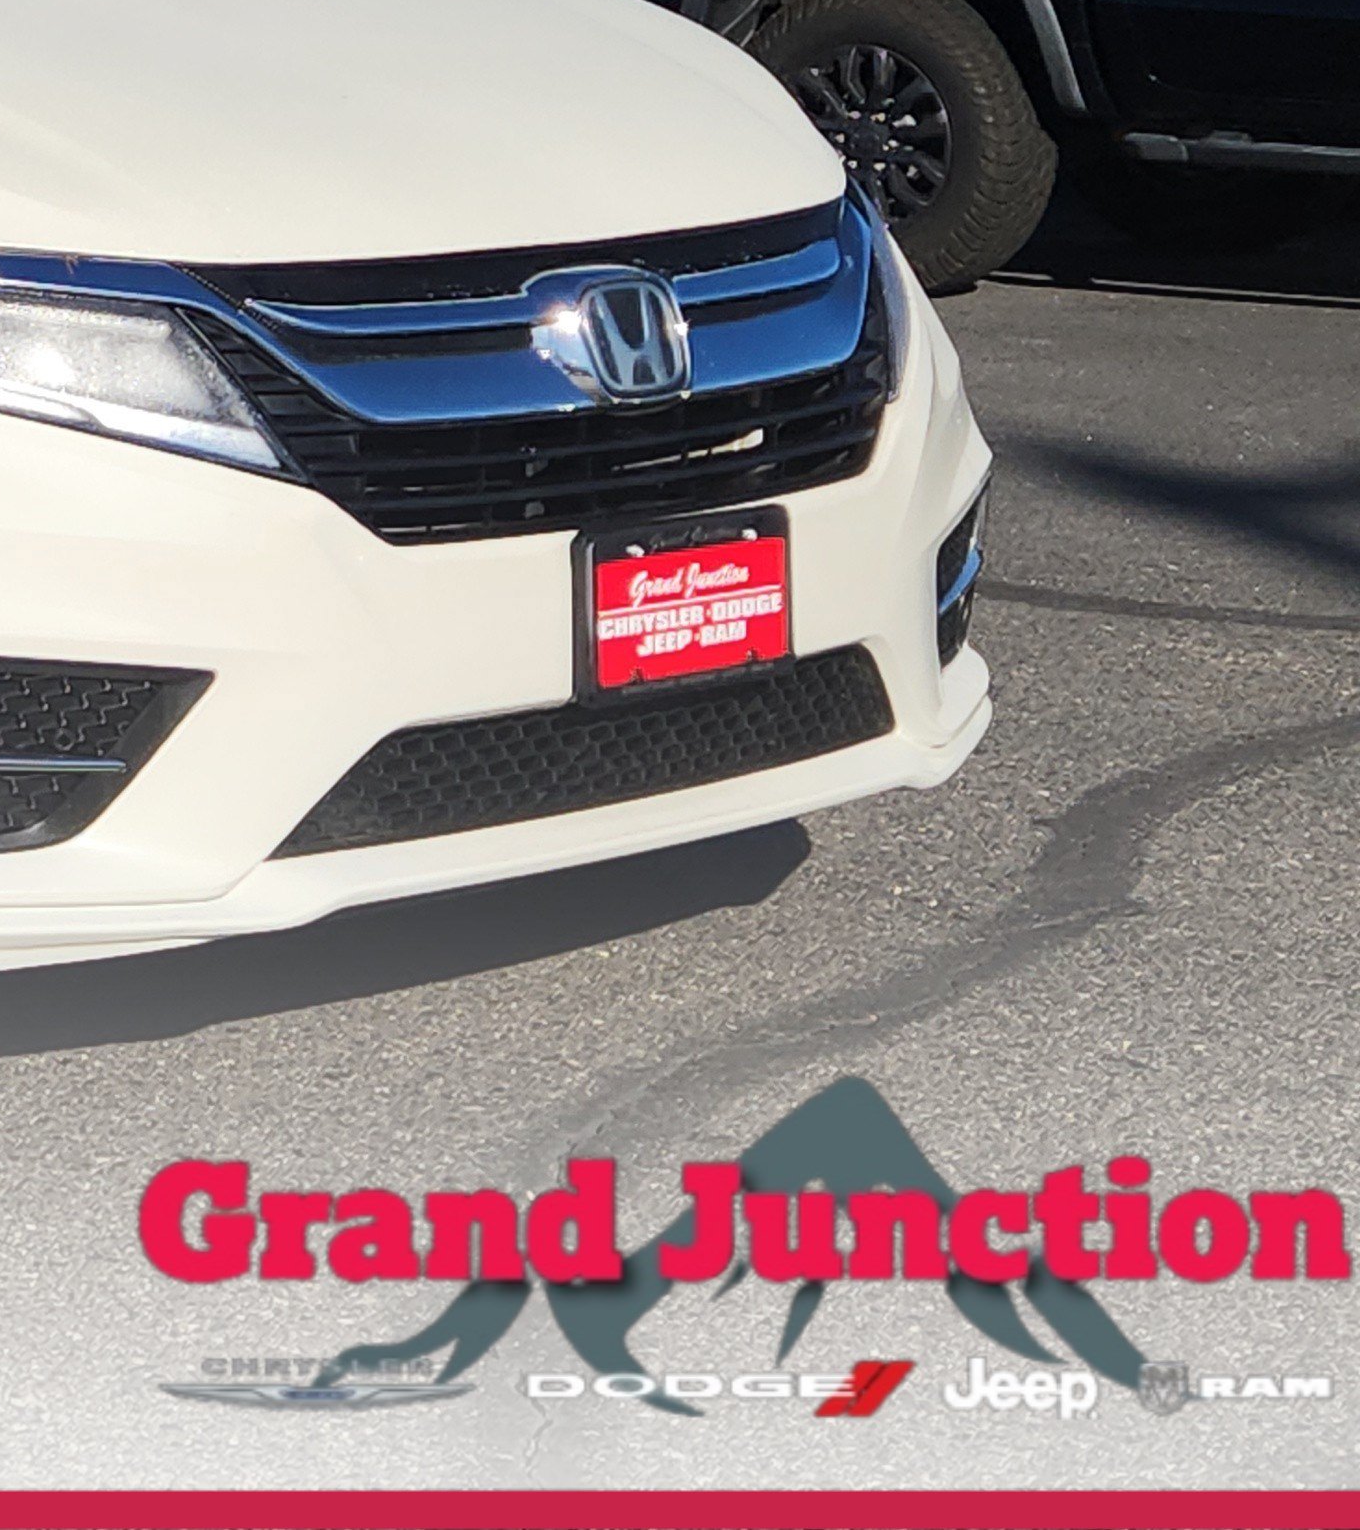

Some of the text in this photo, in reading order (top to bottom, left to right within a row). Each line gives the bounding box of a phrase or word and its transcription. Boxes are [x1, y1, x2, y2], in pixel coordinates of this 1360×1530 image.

[630, 562, 750, 609] Grand Junction
[597, 592, 784, 641] CHRYSLER DODGE
[636, 620, 748, 657] JEEP RAM
